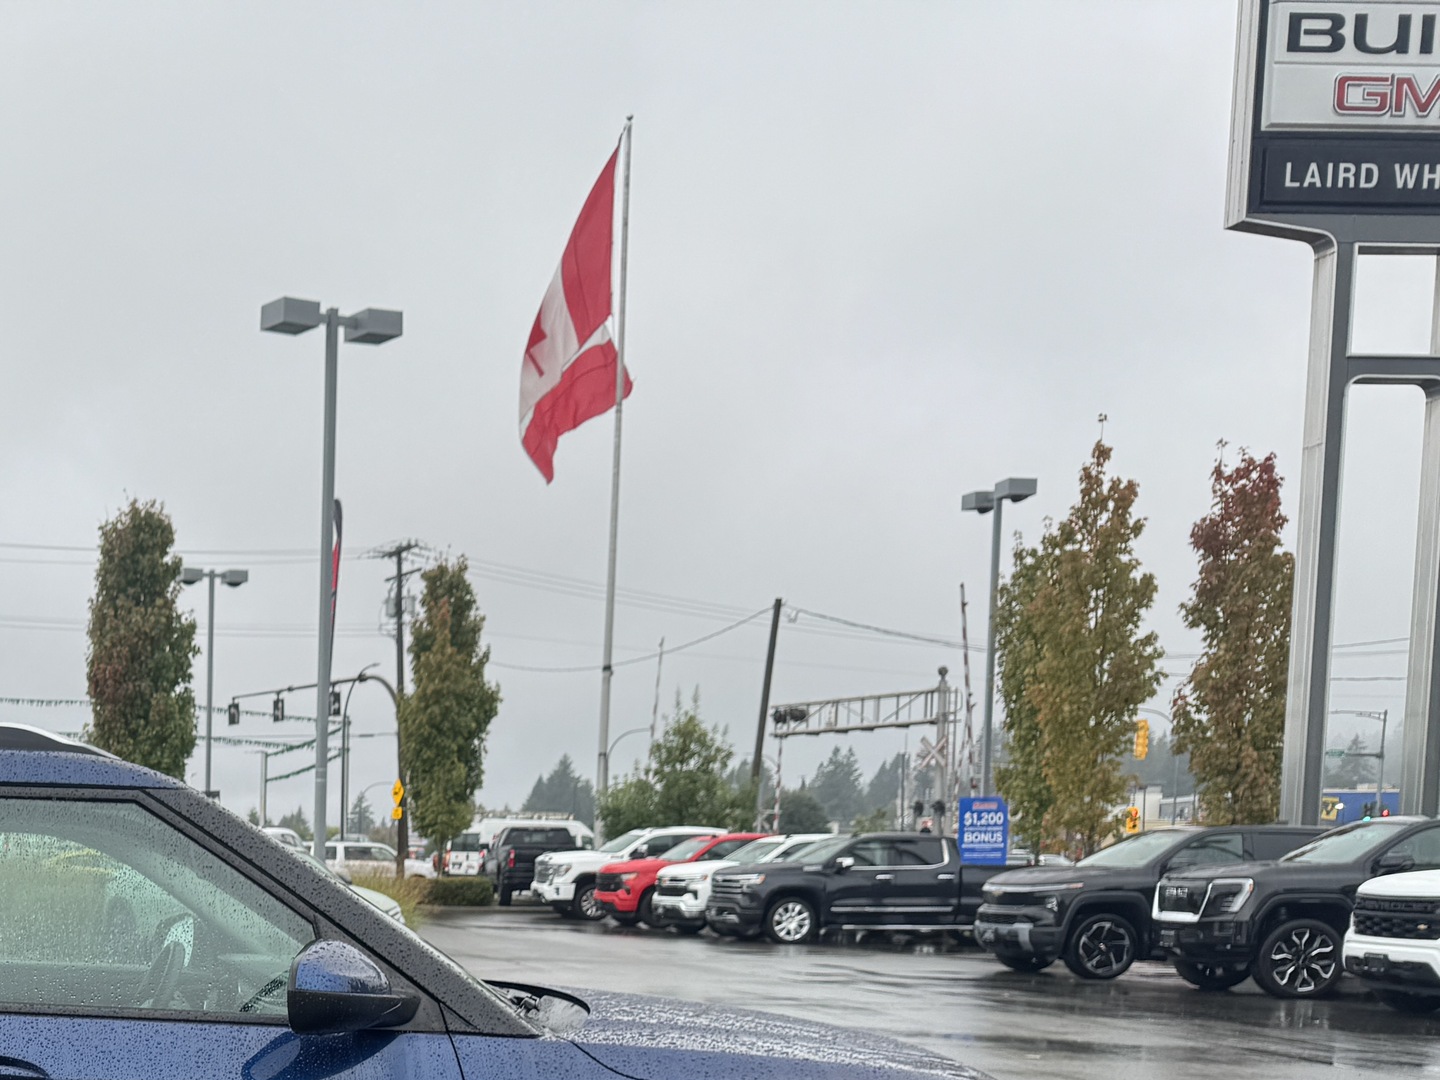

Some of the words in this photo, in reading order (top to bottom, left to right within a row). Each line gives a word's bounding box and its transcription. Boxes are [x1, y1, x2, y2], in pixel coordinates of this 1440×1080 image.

[1284, 162, 1380, 189] LAIRD
[964, 811, 1004, 826] $1,200
[964, 831, 1003, 843] BONUS
